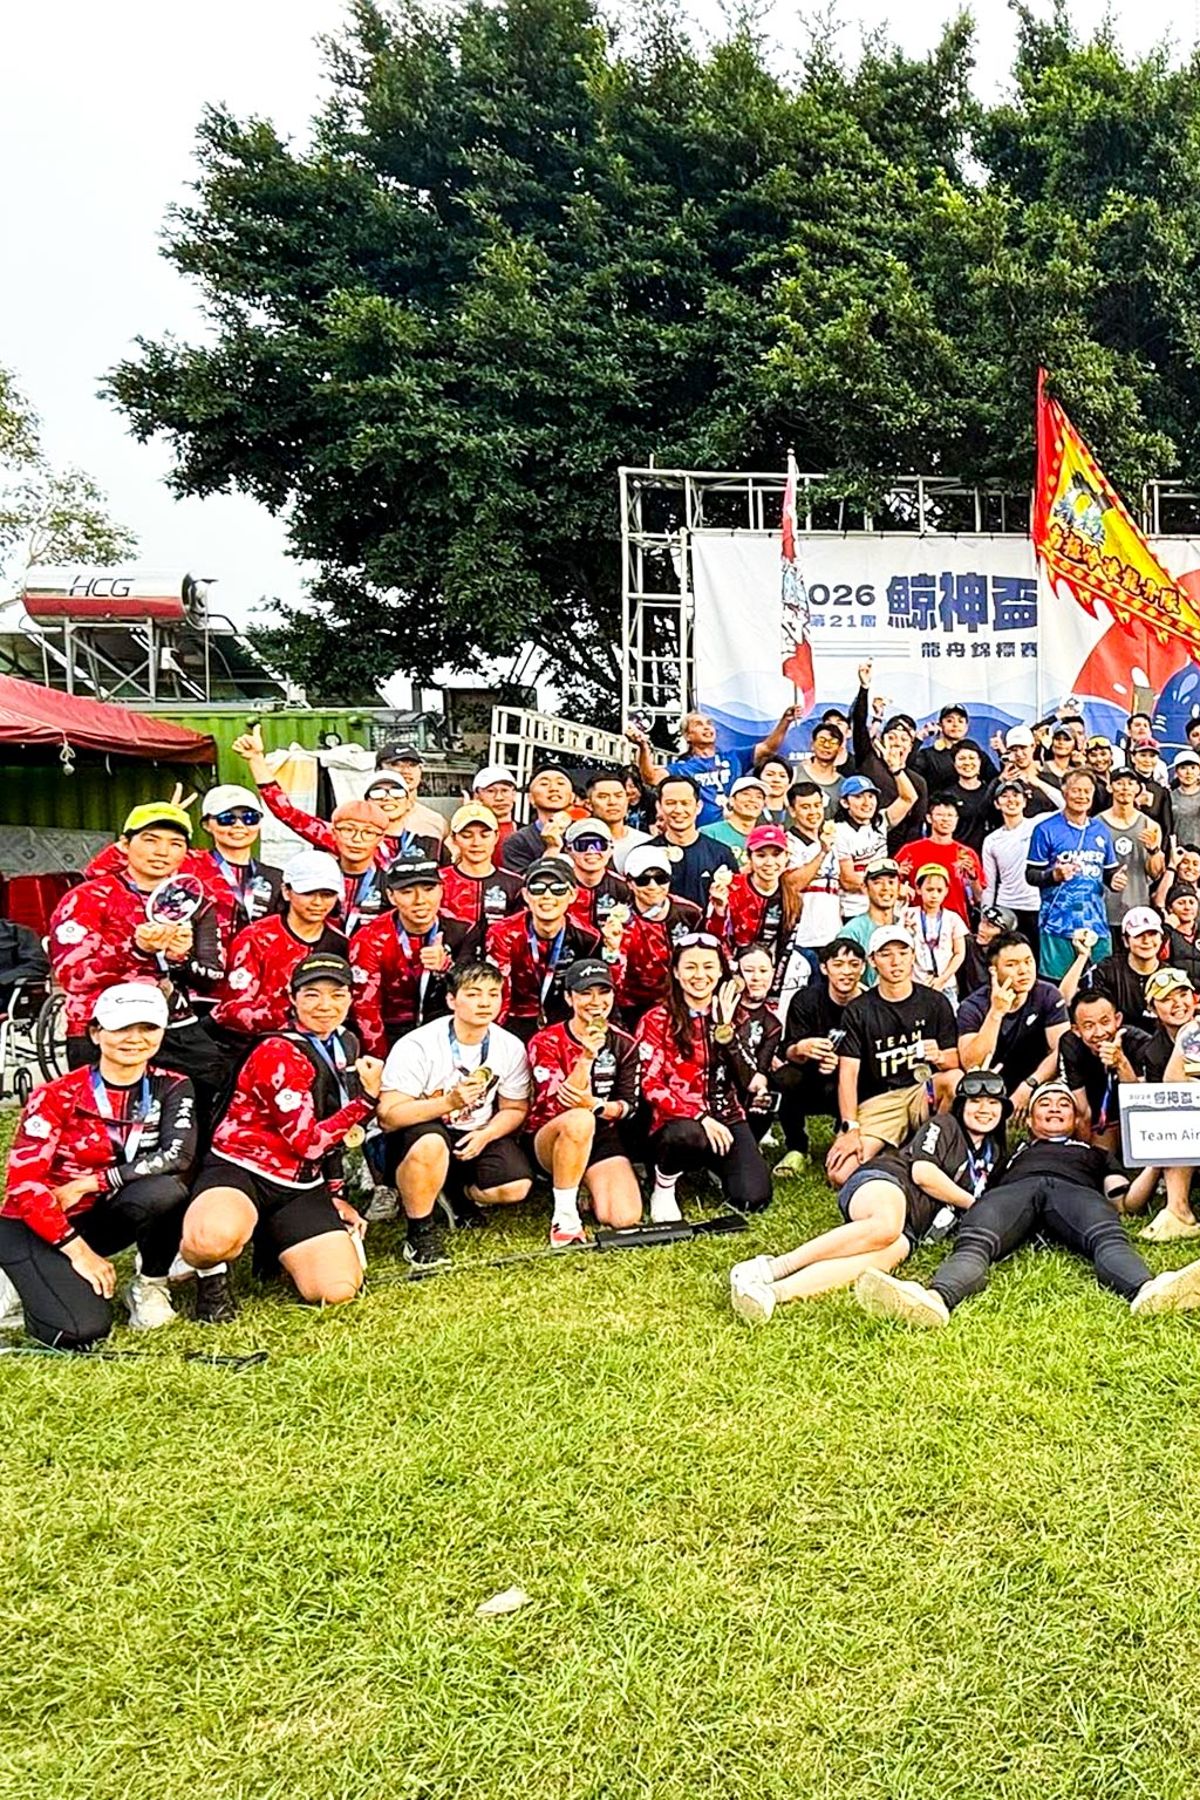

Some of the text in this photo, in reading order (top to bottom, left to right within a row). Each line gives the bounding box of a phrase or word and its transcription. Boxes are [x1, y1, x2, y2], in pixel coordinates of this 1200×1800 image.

[69, 576, 136, 598] HCG
[807, 584, 877, 607] 026
[886, 572, 1038, 633] 鯨神盃
[875, 1031, 922, 1051] TEAM
[875, 1042, 925, 1078] TPE
[1139, 1129, 1178, 1143] Team
